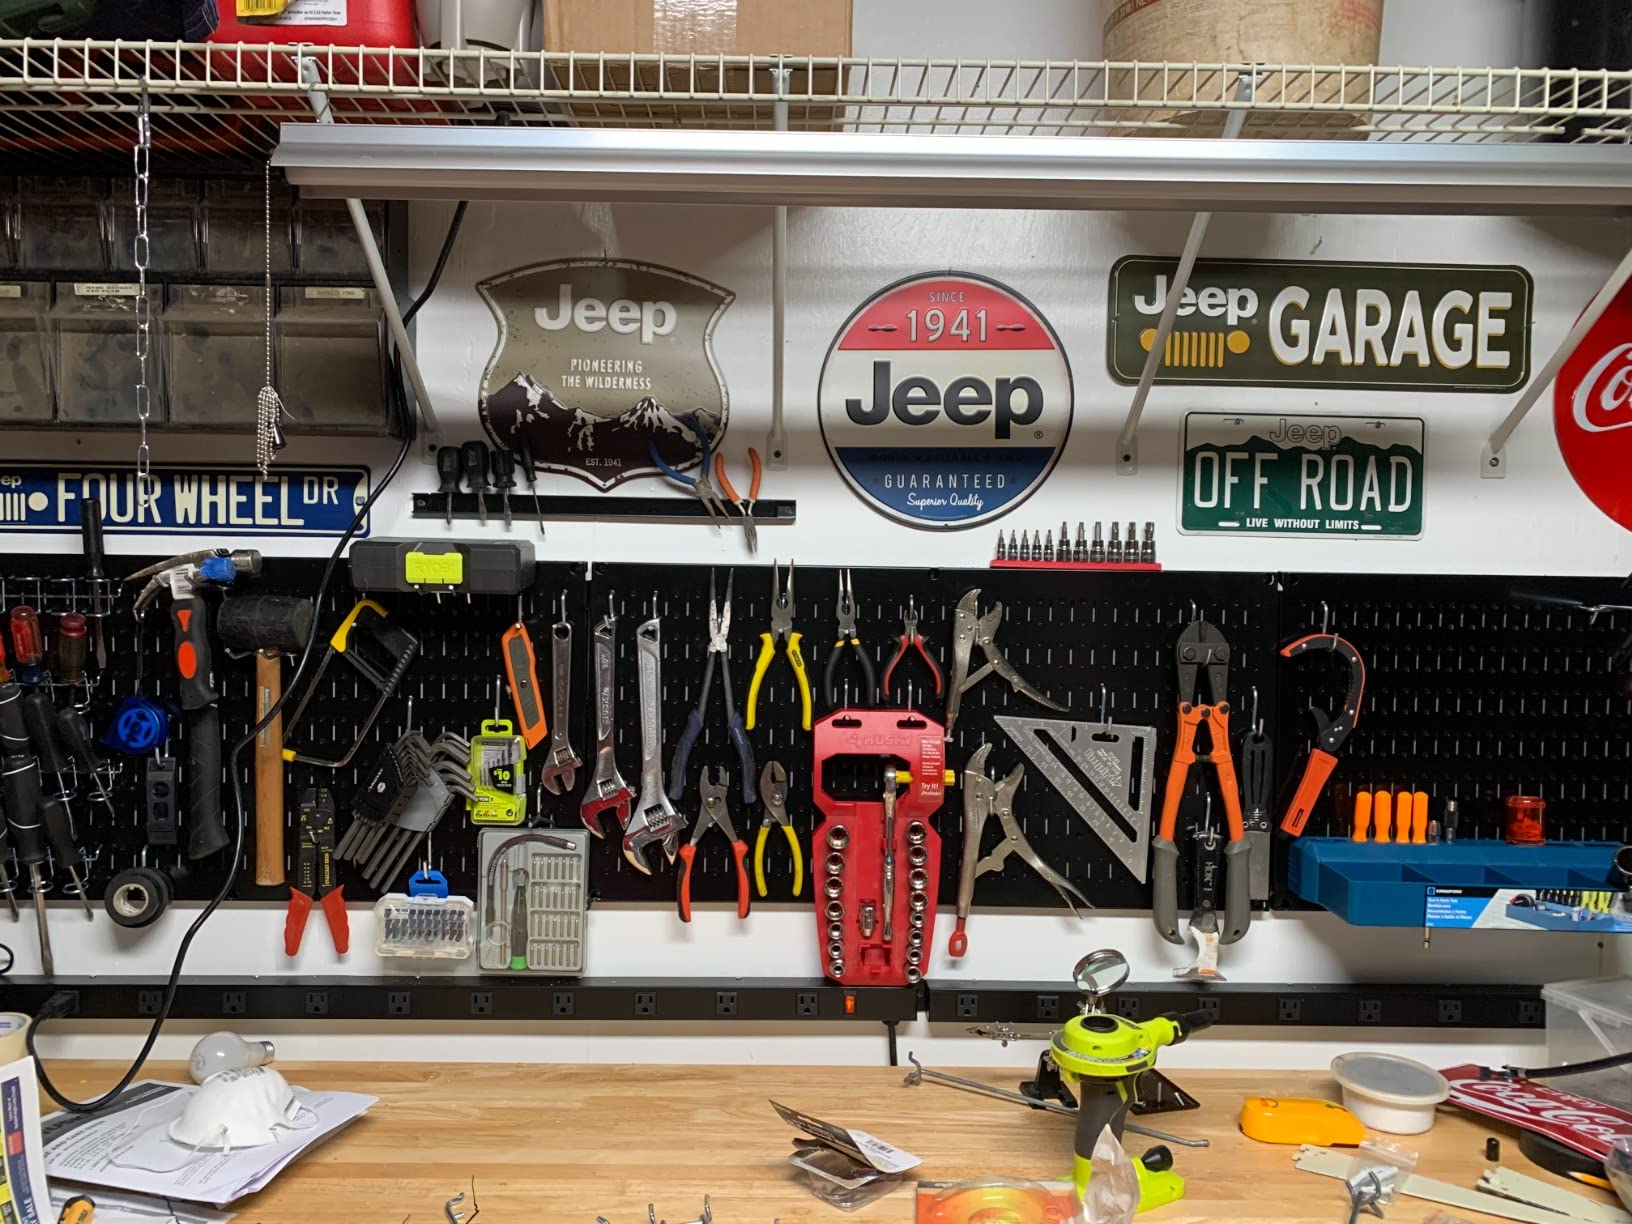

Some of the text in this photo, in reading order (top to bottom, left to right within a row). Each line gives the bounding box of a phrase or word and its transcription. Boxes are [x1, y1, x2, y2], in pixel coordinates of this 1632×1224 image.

[929, 291, 965, 303] SINCE
[534, 283, 678, 344] Jeep
[1133, 274, 1513, 369] Jeep GARAGE
[906, 308, 988, 342] 1941
[570, 358, 643, 374] PIONEERING
[561, 375, 652, 390] THE WILDERNESS
[845, 360, 1044, 440] Jeep
[1269, 418, 1343, 451] Jeep
[586, 458, 622, 467] EST. 1941
[884, 474, 1006, 489] GUARANTEED
[1193, 450, 1414, 513] OFF ROAD
[57, 472, 339, 526] FOUR WHEEL DR
[907, 492, 984, 511] Superior Quality
[1245, 517, 1360, 531] LIVE WITHOUT LIMITS
[920, 782, 931, 791] Try
[23, 1197, 35, 1218] SALE
